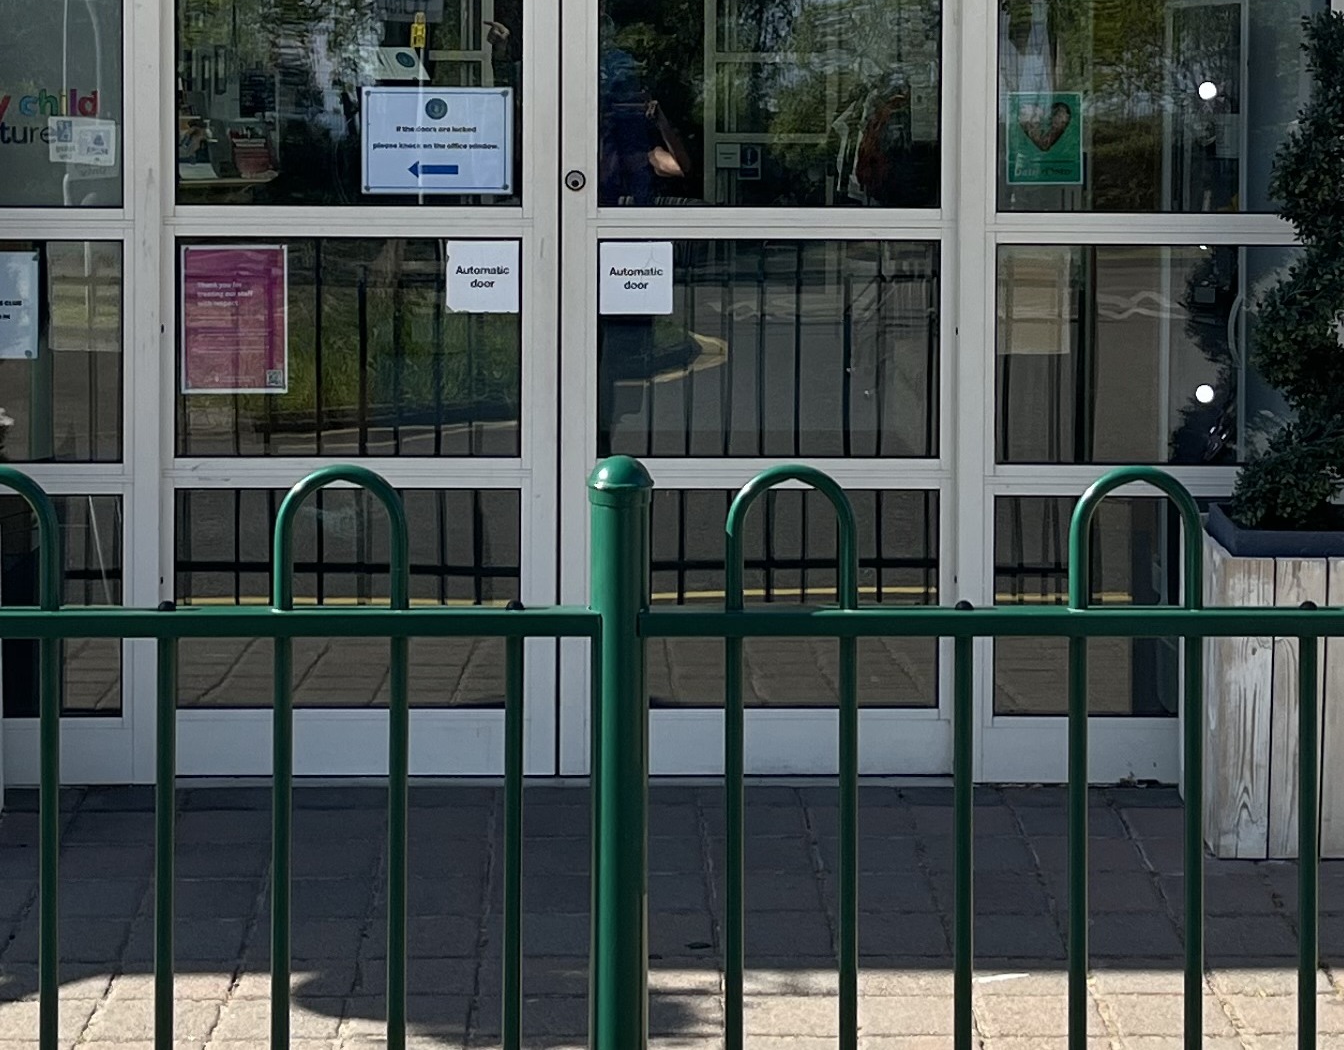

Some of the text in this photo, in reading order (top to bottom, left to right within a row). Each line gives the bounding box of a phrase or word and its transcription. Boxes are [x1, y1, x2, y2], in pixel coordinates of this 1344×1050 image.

[19, 88, 99, 117] child
[455, 265, 510, 276] Automatic
[609, 266, 664, 277] Automatic
[470, 279, 495, 289] door
[623, 280, 649, 290] door
